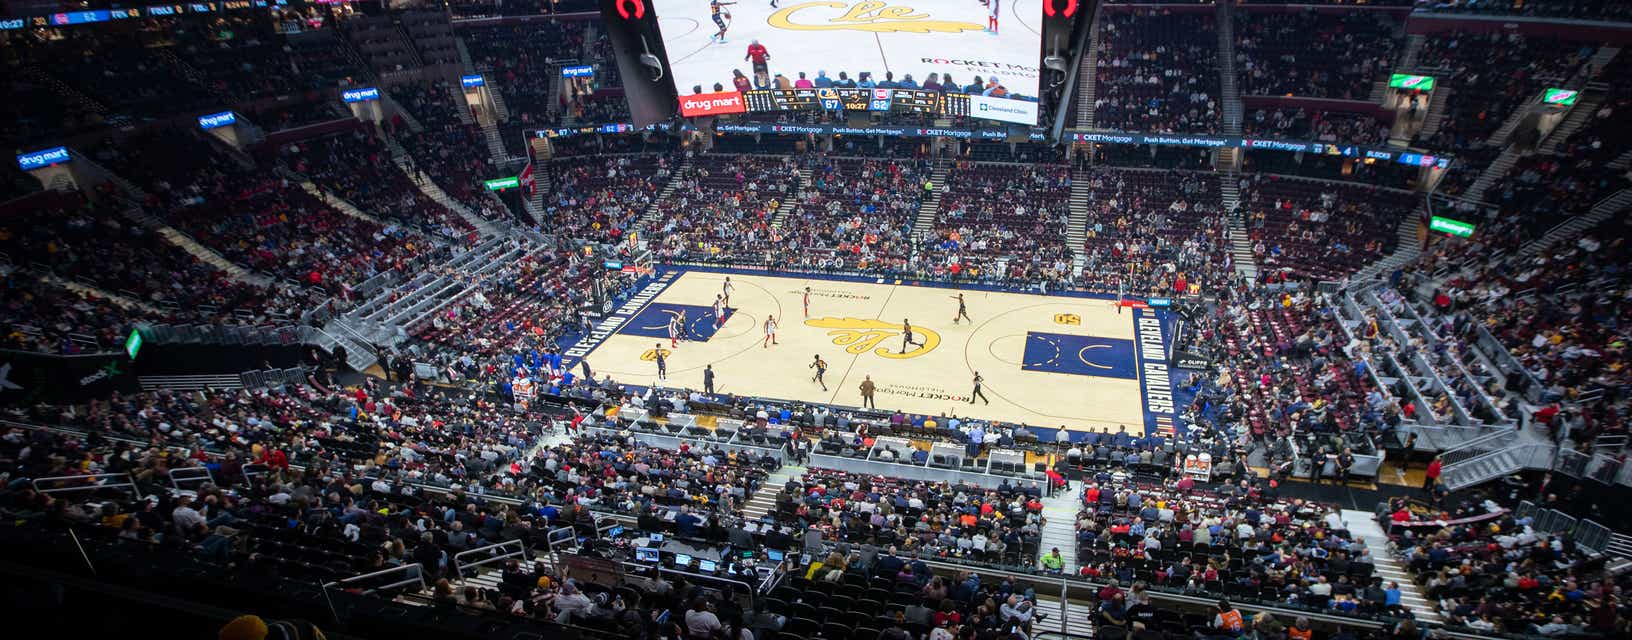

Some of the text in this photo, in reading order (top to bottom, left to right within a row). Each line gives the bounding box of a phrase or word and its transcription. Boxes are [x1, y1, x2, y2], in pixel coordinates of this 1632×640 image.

[921, 58, 1000, 68] ROCKET
[562, 66, 593, 76] drug mart
[343, 88, 378, 100] drug mart
[684, 99, 711, 110] drug
[713, 97, 740, 107] mart
[825, 100, 838, 109] 67
[873, 100, 886, 109] 62
[989, 106, 1013, 114] Cleveland
[201, 112, 235, 127] drug mart
[797, 126, 823, 134] Mortgage
[1073, 133, 1132, 143] ROCKET Mortgage
[1241, 140, 1271, 148] ROCKET
[1272, 142, 1306, 151] Mortgage
[19, 148, 68, 165] drug mart
[565, 282, 667, 357] CLEVELAND CAVALIERS
[1139, 318, 1166, 360] CLEVELAND
[1144, 363, 1175, 414] CAVALIERS
[918, 392, 970, 402] ROCKET
